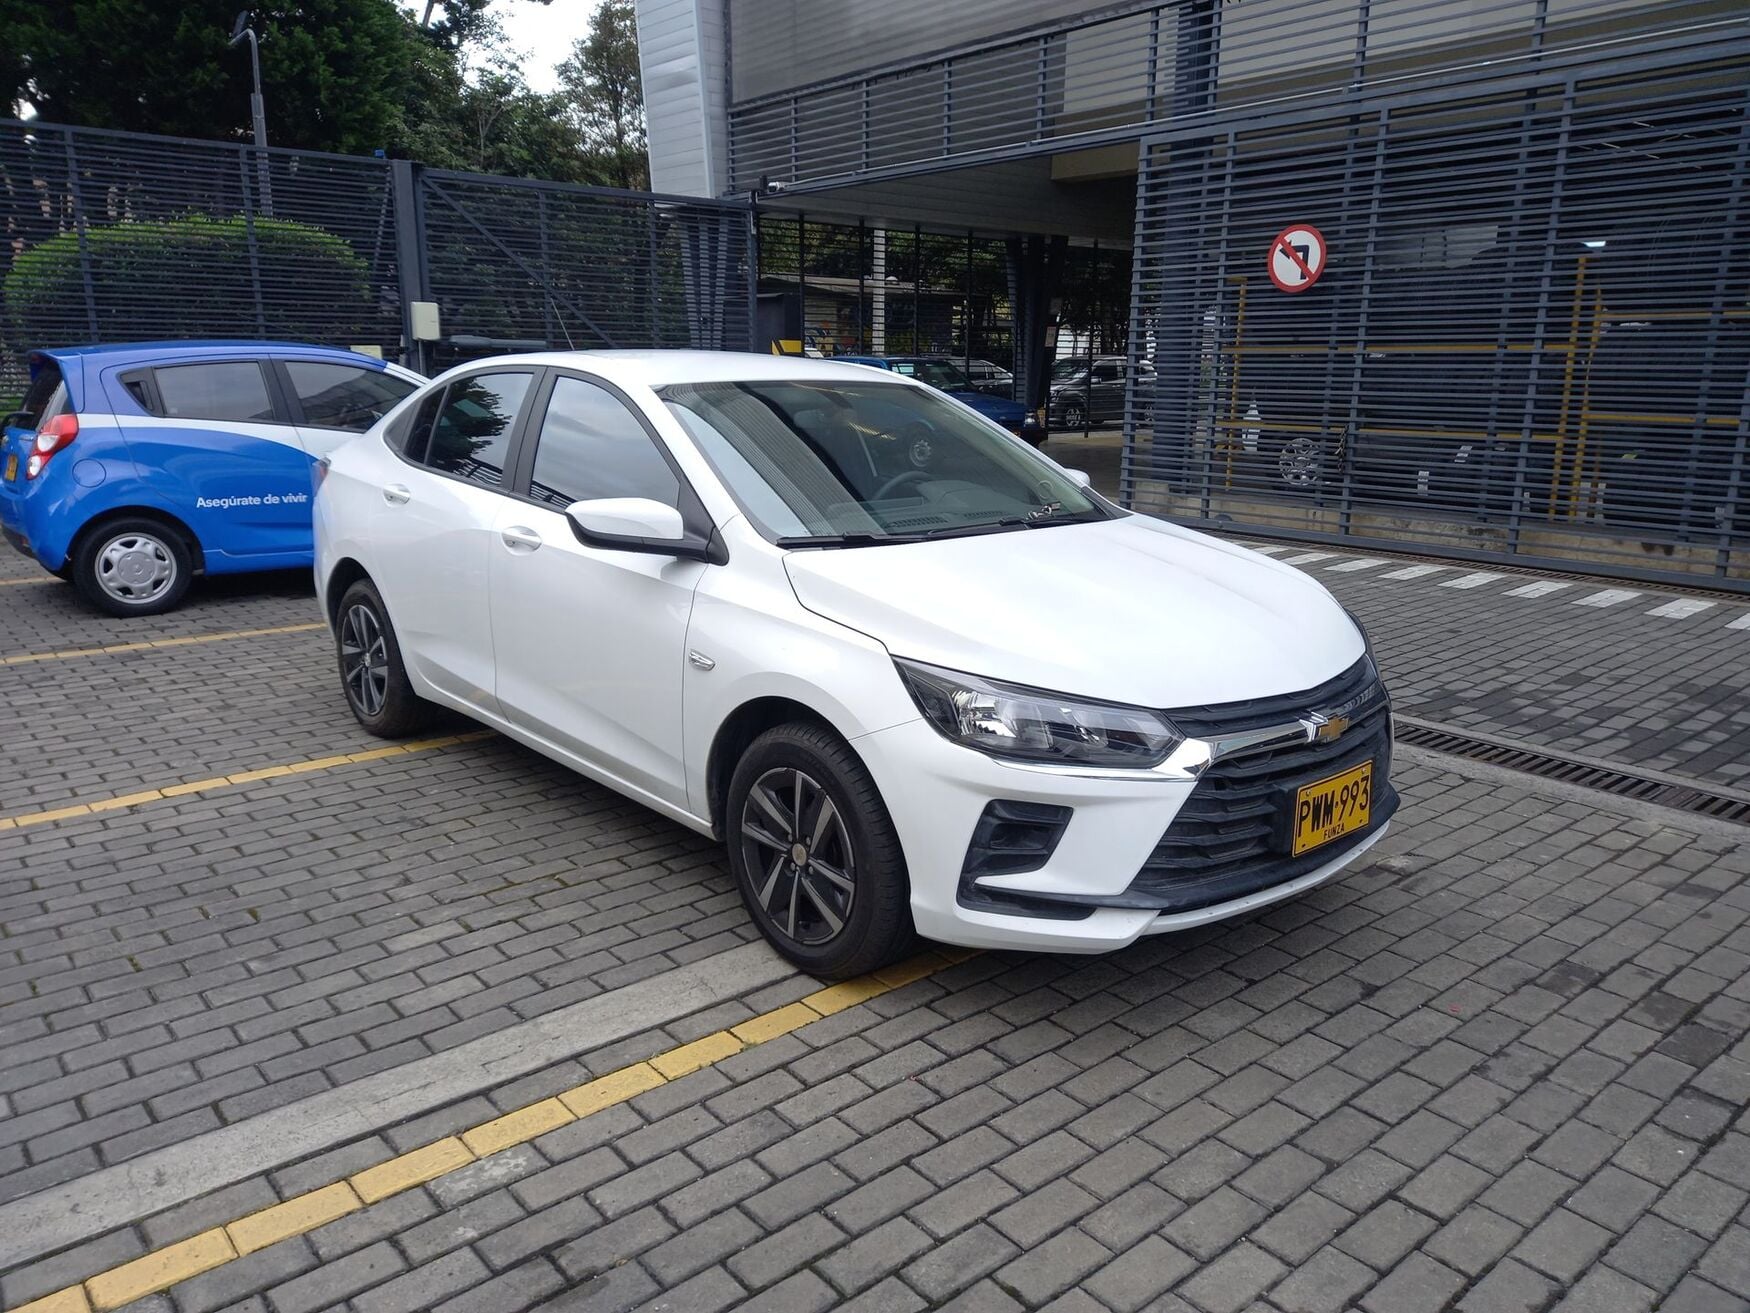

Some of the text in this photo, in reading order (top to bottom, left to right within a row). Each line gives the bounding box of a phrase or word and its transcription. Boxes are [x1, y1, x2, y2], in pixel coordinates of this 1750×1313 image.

[196, 492, 308, 509] Asegúrate de vivir
[1323, 822, 1345, 840] FUNZA
